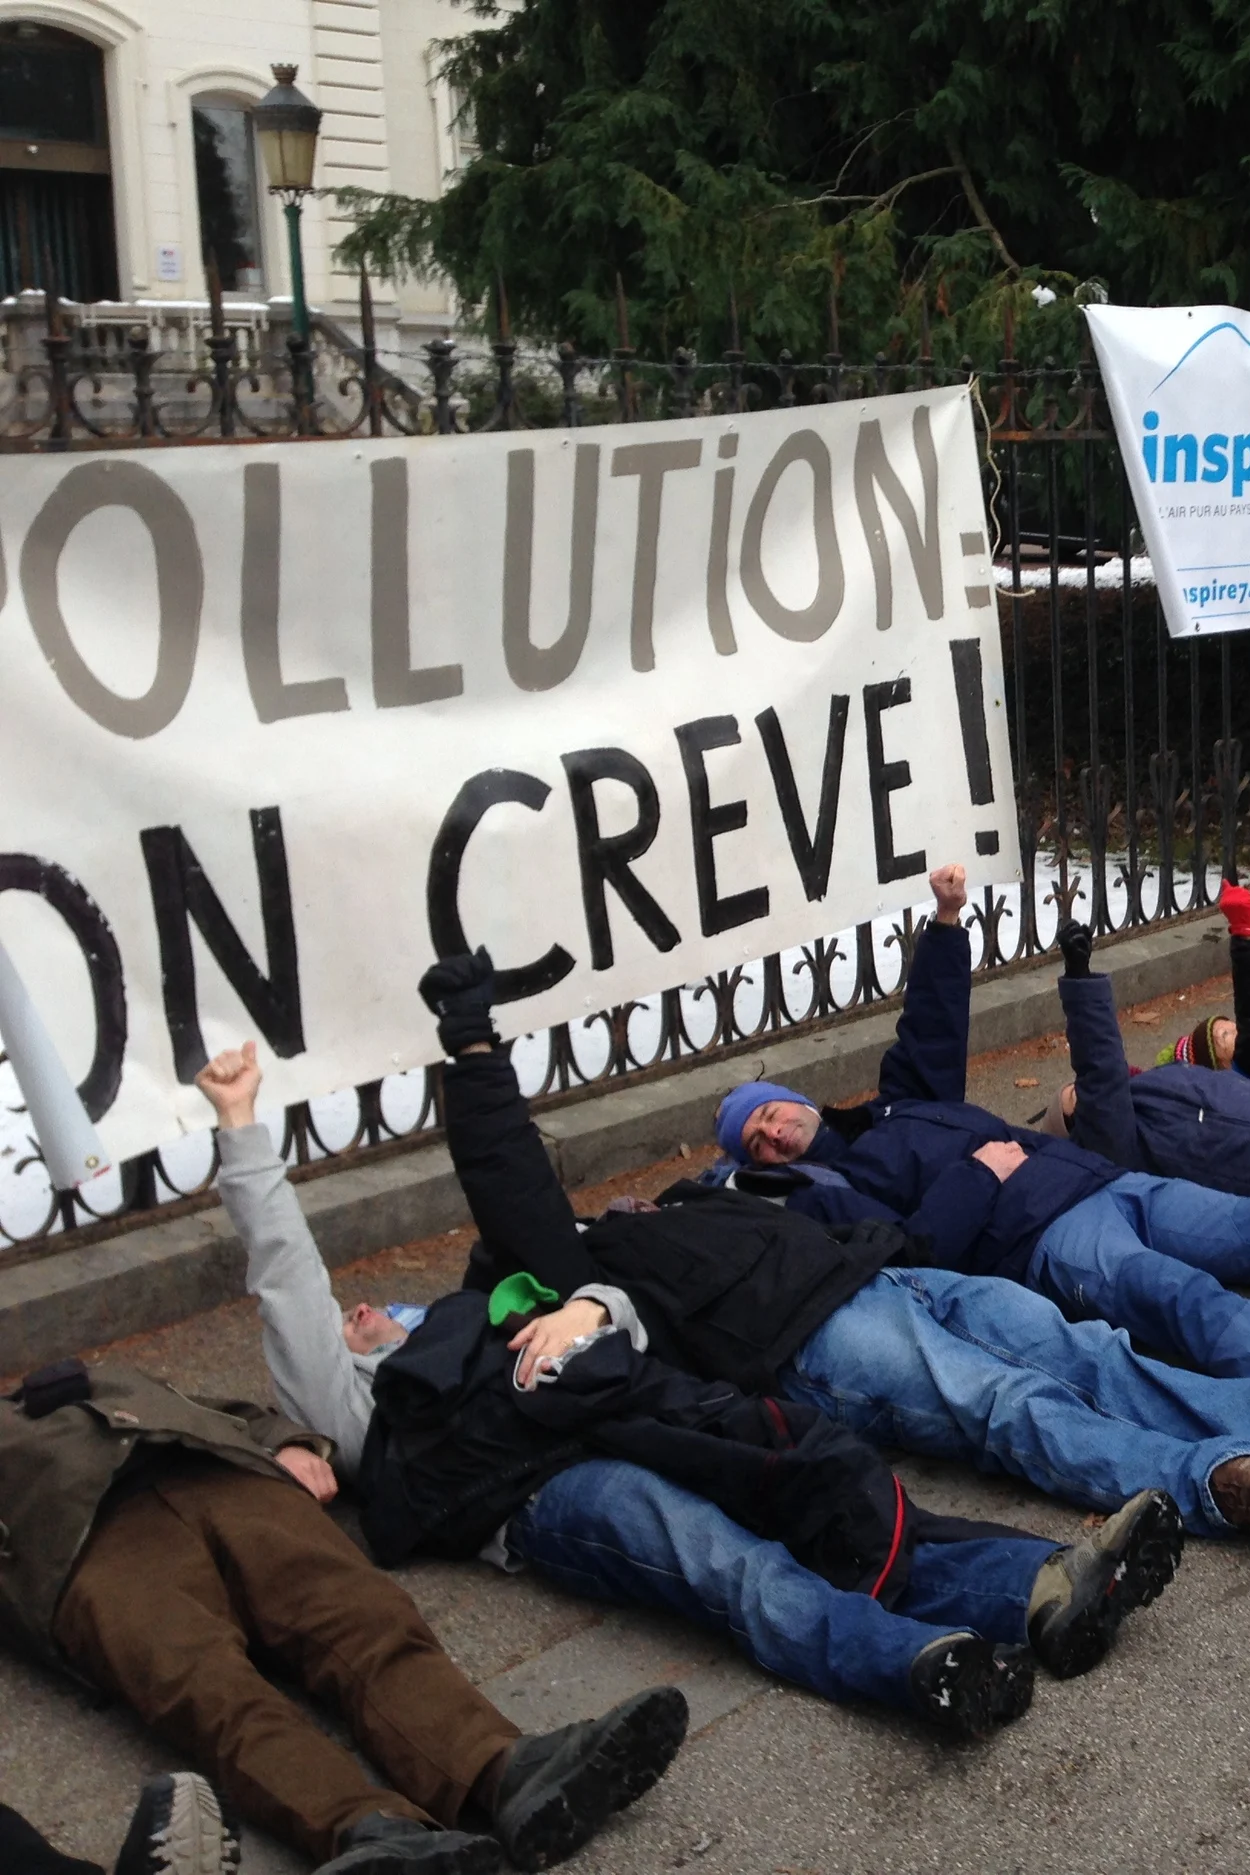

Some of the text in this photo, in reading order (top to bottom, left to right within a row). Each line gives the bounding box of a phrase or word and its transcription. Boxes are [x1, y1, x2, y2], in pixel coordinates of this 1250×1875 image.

[0, 405, 991, 740] OLLUTiON=
[1190, 504, 1212, 518] PUR
[1213, 504, 1228, 517] AU
